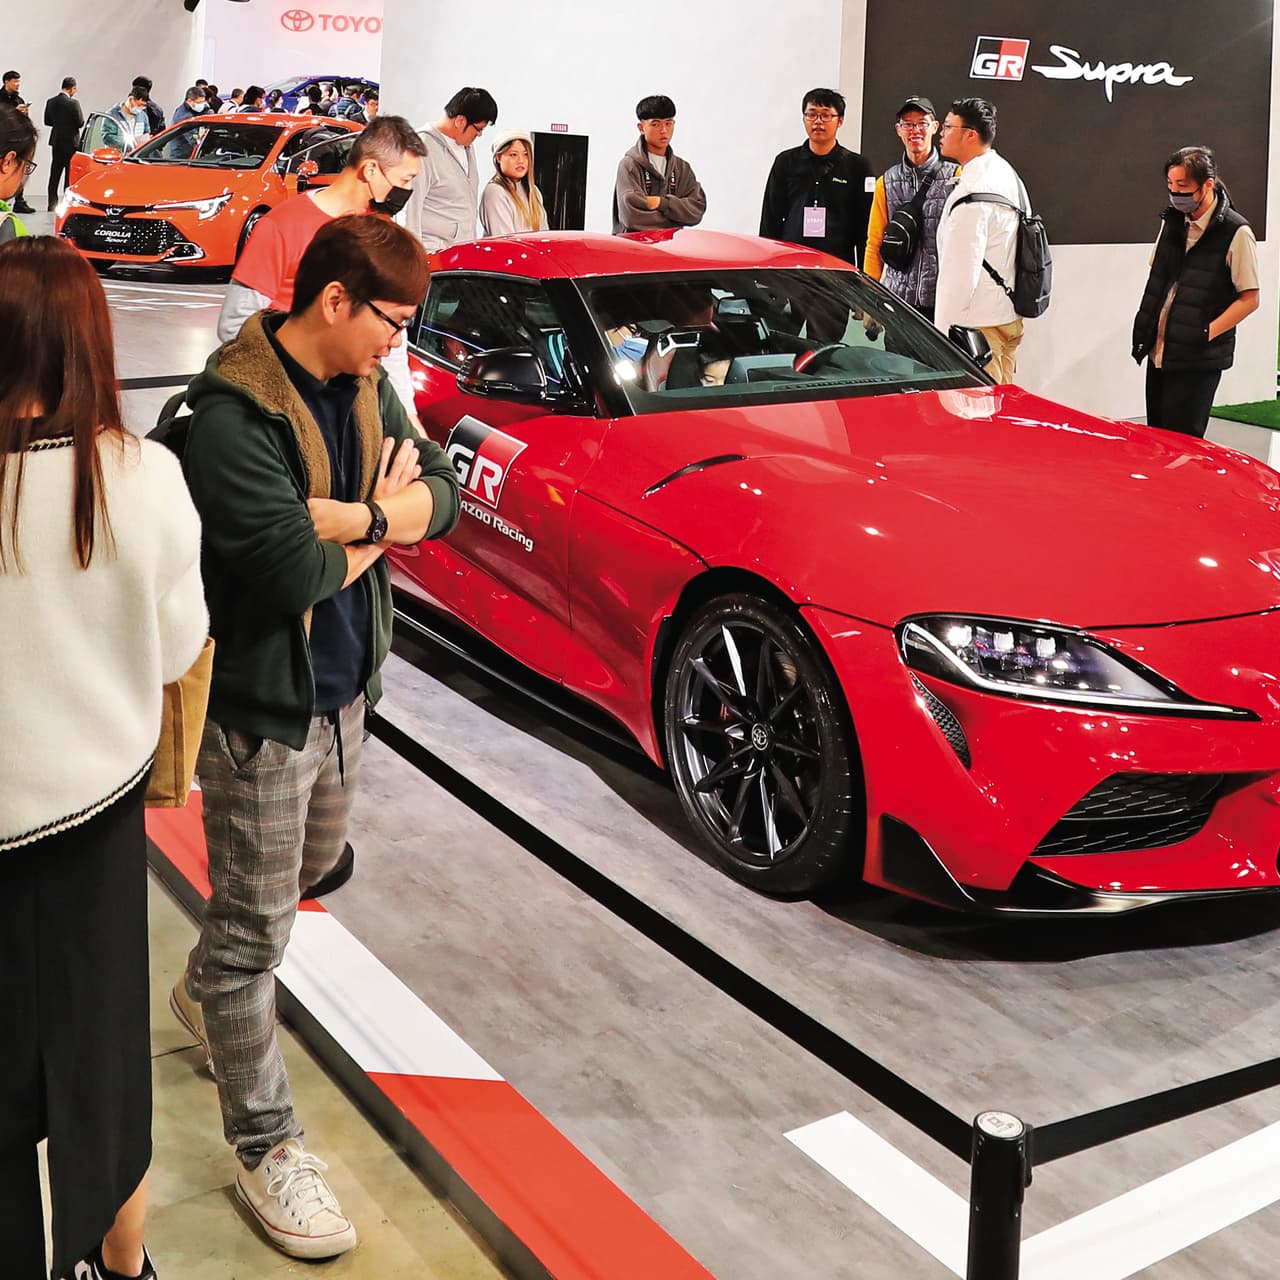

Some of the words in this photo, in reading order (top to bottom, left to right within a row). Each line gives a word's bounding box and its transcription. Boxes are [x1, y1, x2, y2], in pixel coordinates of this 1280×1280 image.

[318, 14, 385, 34] TOYO
[972, 52, 1024, 78] GR
[1031, 44, 1194, 104] Supra
[94, 229, 132, 238] COROLLA
[448, 442, 504, 503] GR
[460, 498, 491, 526] AZOO
[492, 515, 534, 553] Racing
